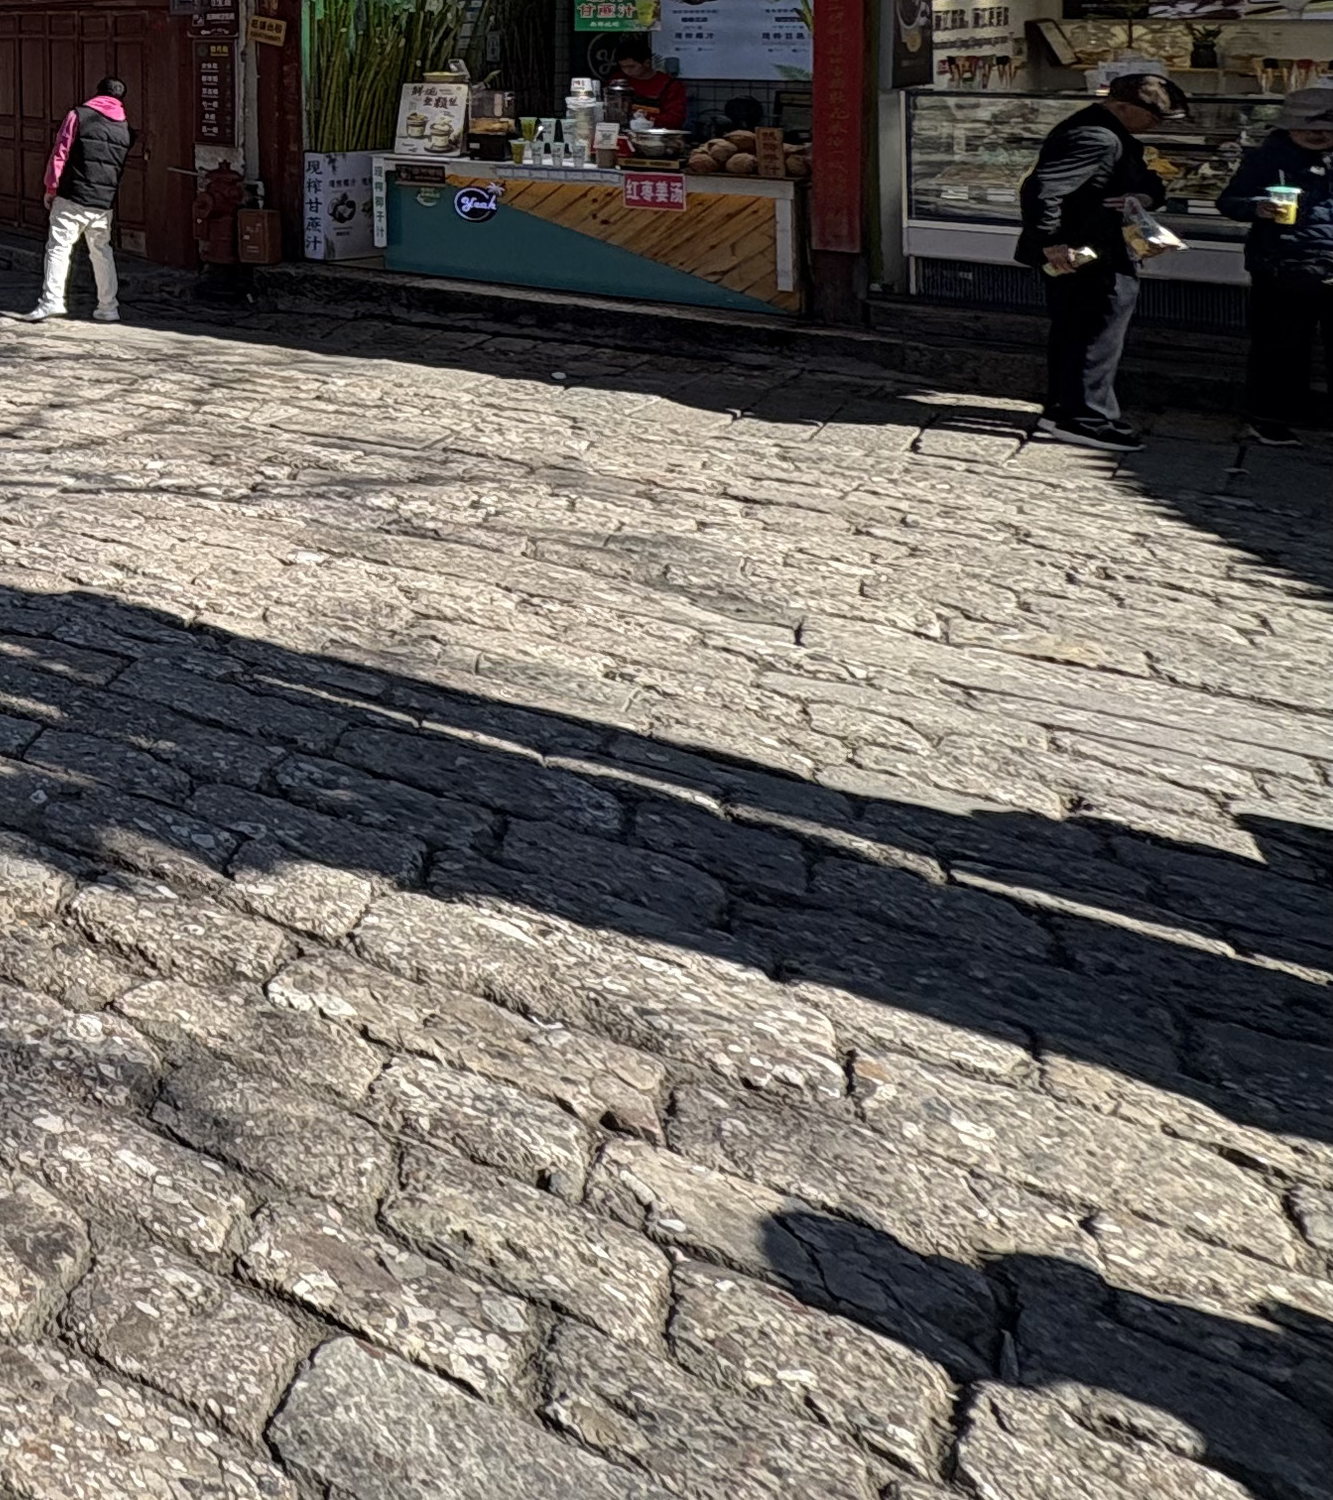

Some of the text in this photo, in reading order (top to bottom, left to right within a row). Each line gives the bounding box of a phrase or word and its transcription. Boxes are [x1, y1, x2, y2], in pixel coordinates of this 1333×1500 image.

[459, 194, 498, 212] Yeah
[625, 178, 684, 204] 红枣姜汤
[306, 160, 323, 251] 现榨甘蔗汁
